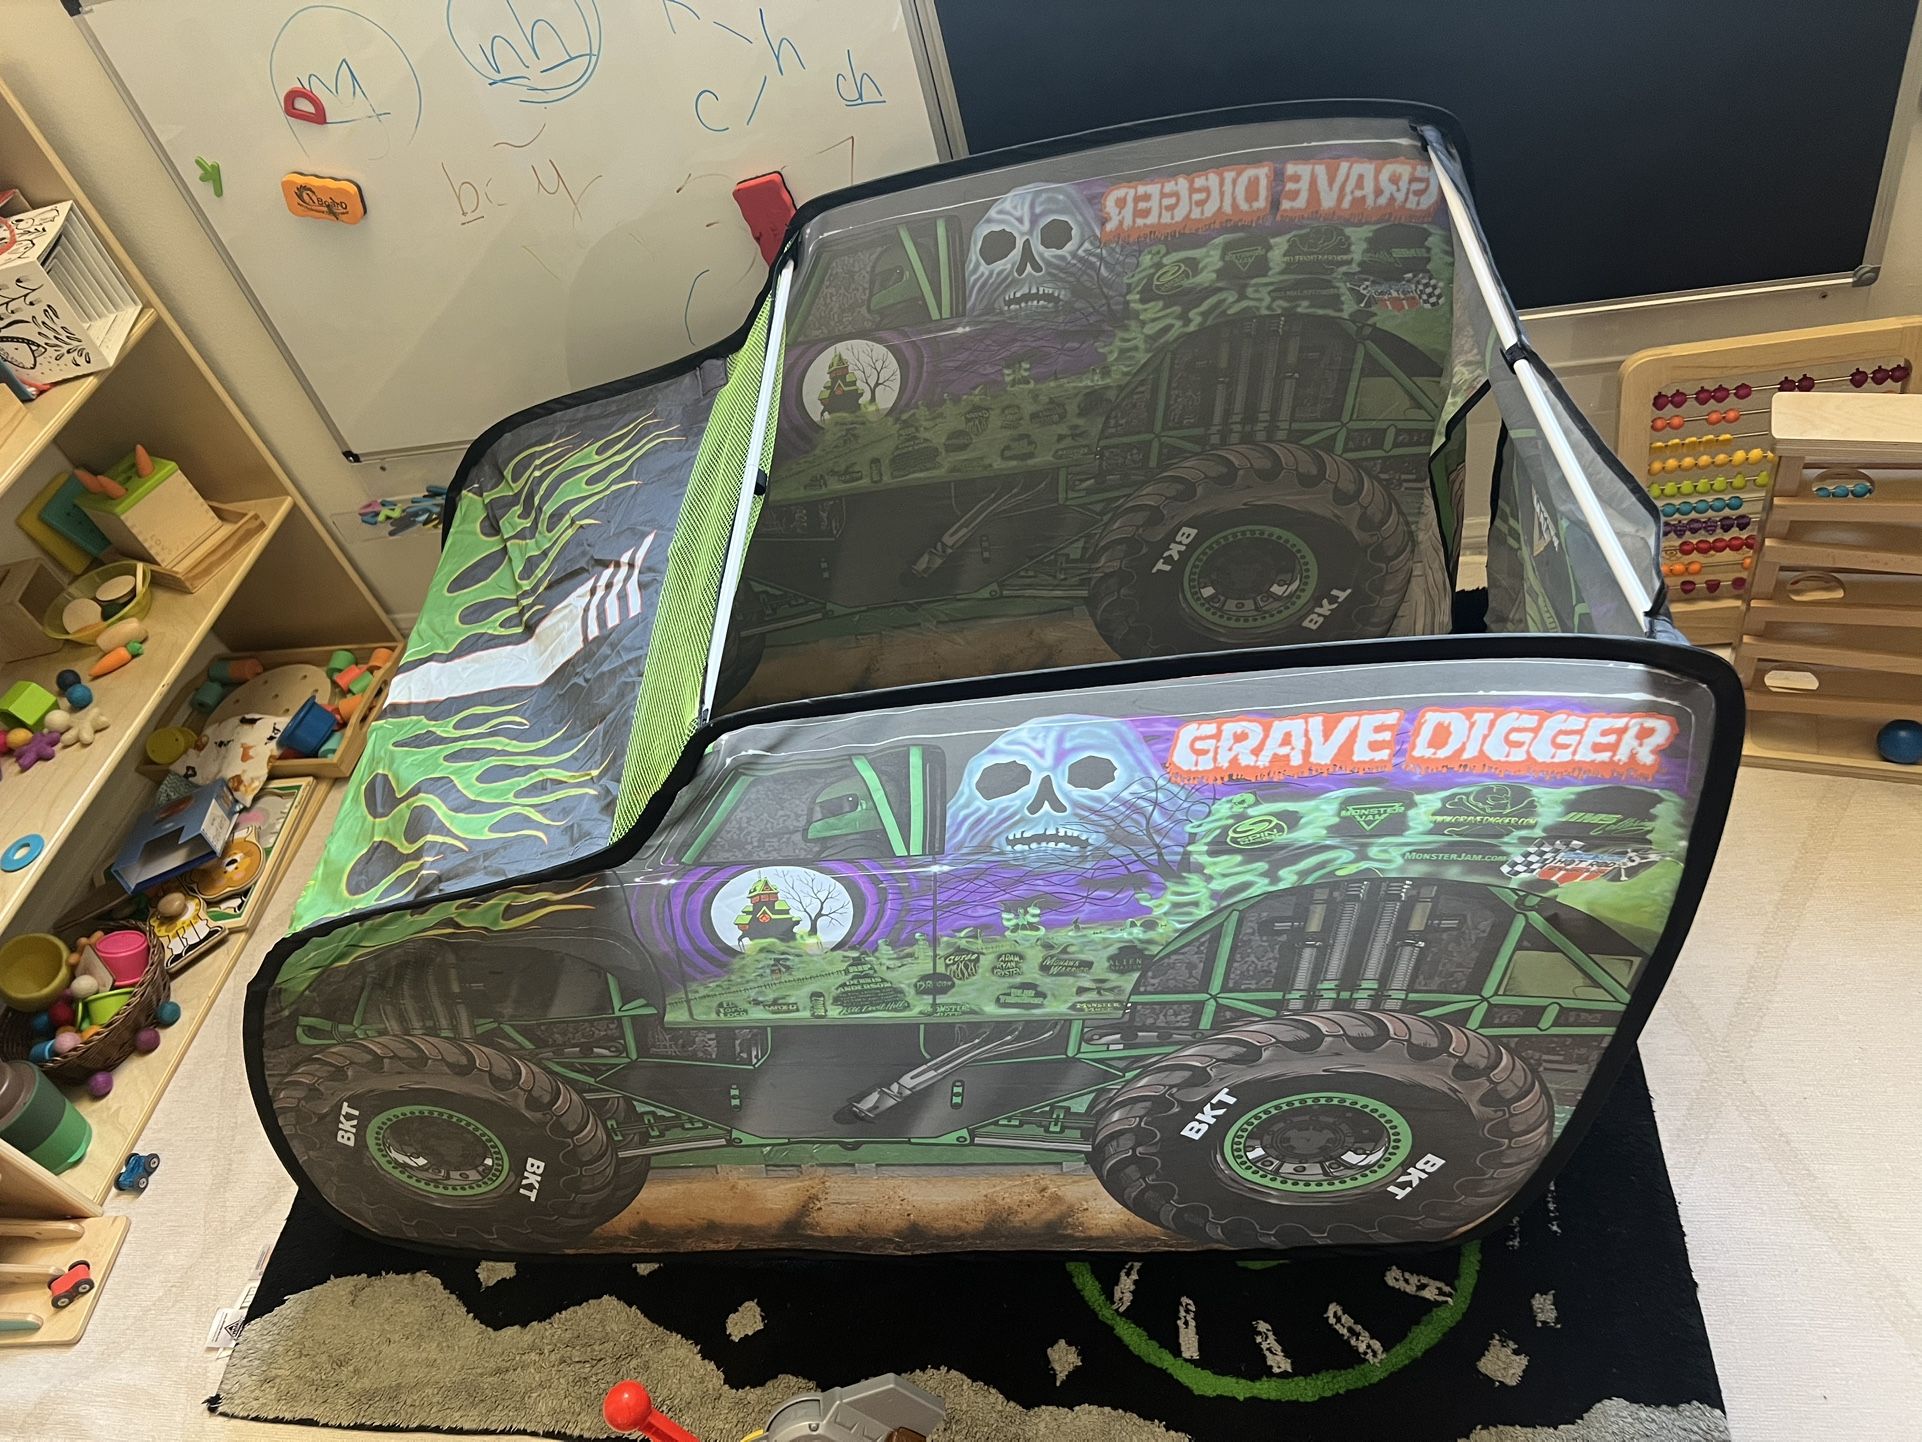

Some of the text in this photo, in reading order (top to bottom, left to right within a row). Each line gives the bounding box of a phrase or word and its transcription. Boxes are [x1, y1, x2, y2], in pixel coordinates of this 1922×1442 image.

[1172, 711, 1672, 772] GRAVE DIGGER
[336, 1102, 360, 1147] BKT
[1179, 1087, 1240, 1141] BKT
[518, 1156, 546, 1202] BKT
[1386, 1152, 1447, 1200] BKT
